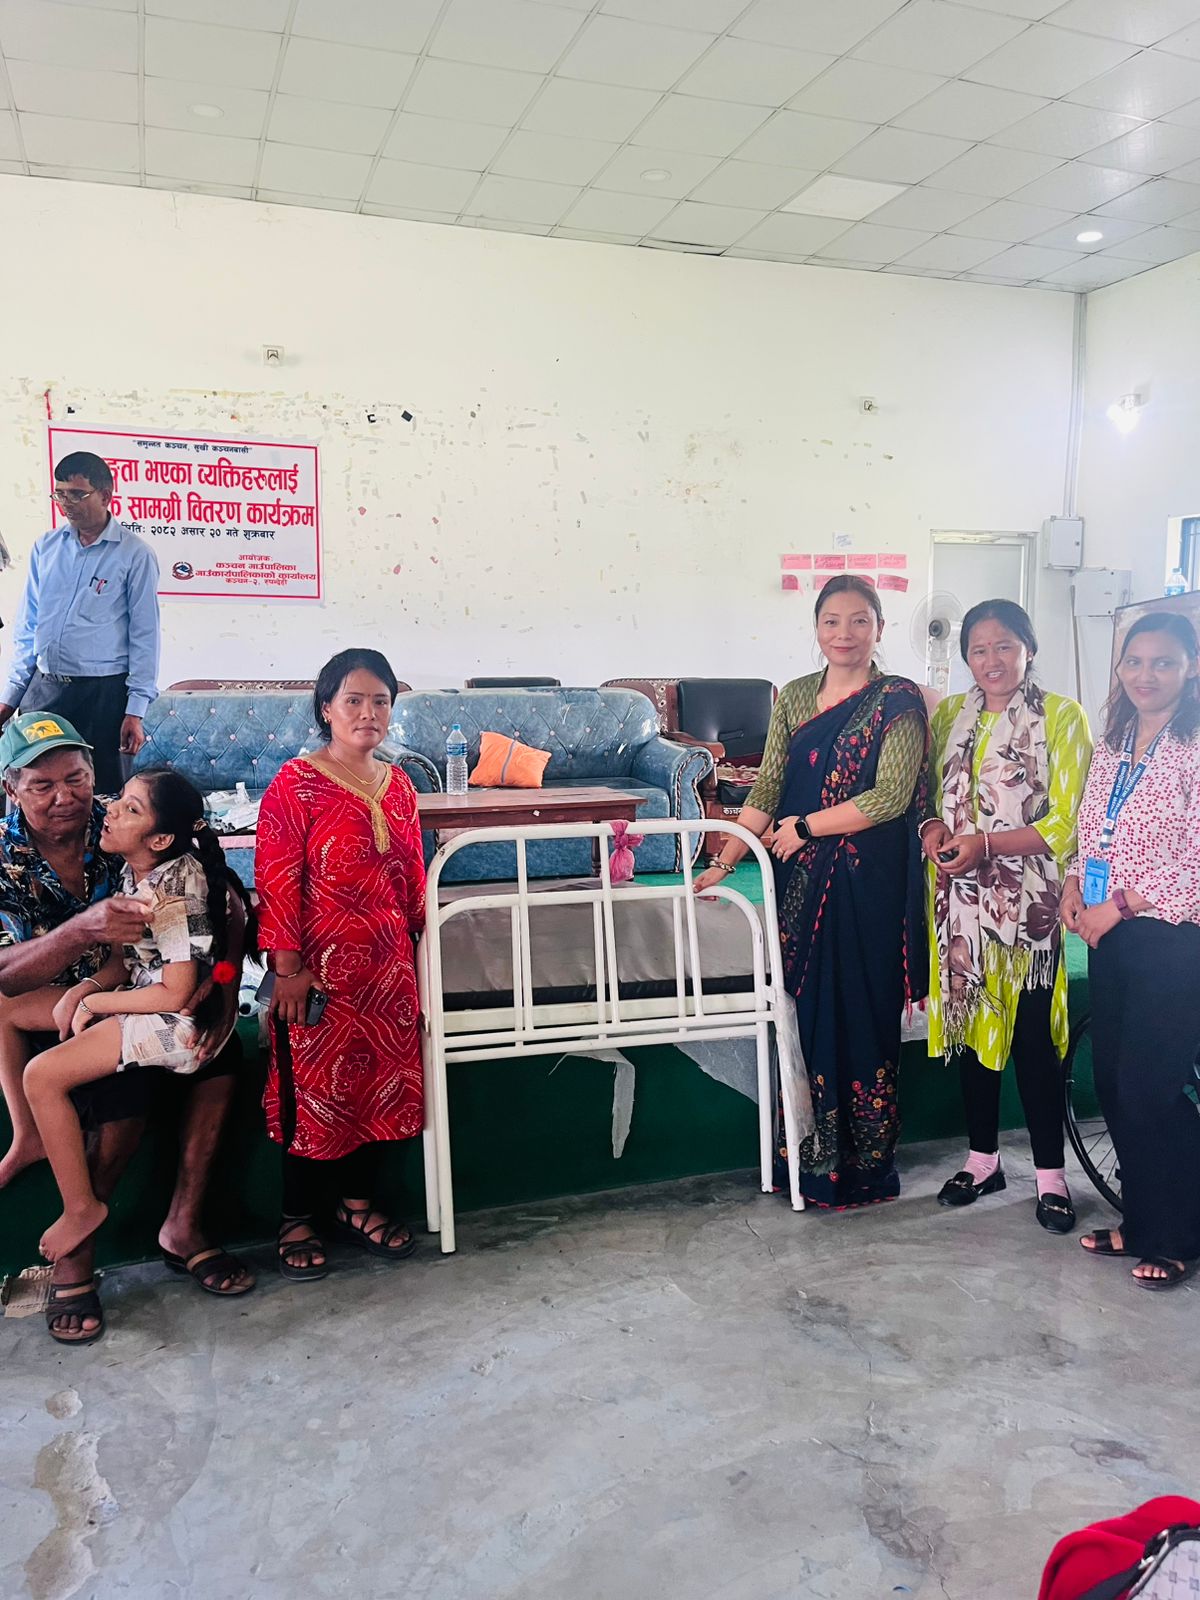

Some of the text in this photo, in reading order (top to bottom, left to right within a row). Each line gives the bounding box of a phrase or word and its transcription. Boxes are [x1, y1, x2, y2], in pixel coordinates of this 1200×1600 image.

[145, 460, 192, 485] भएका
[128, 491, 182, 525] सामग्री
[187, 491, 241, 524] वितरण
[247, 498, 315, 527] कार्यक्रम
[151, 525, 176, 536] २०८२
[181, 526, 206, 537] असार
[209, 528, 221, 538] २०
[226, 527, 239, 537] गते
